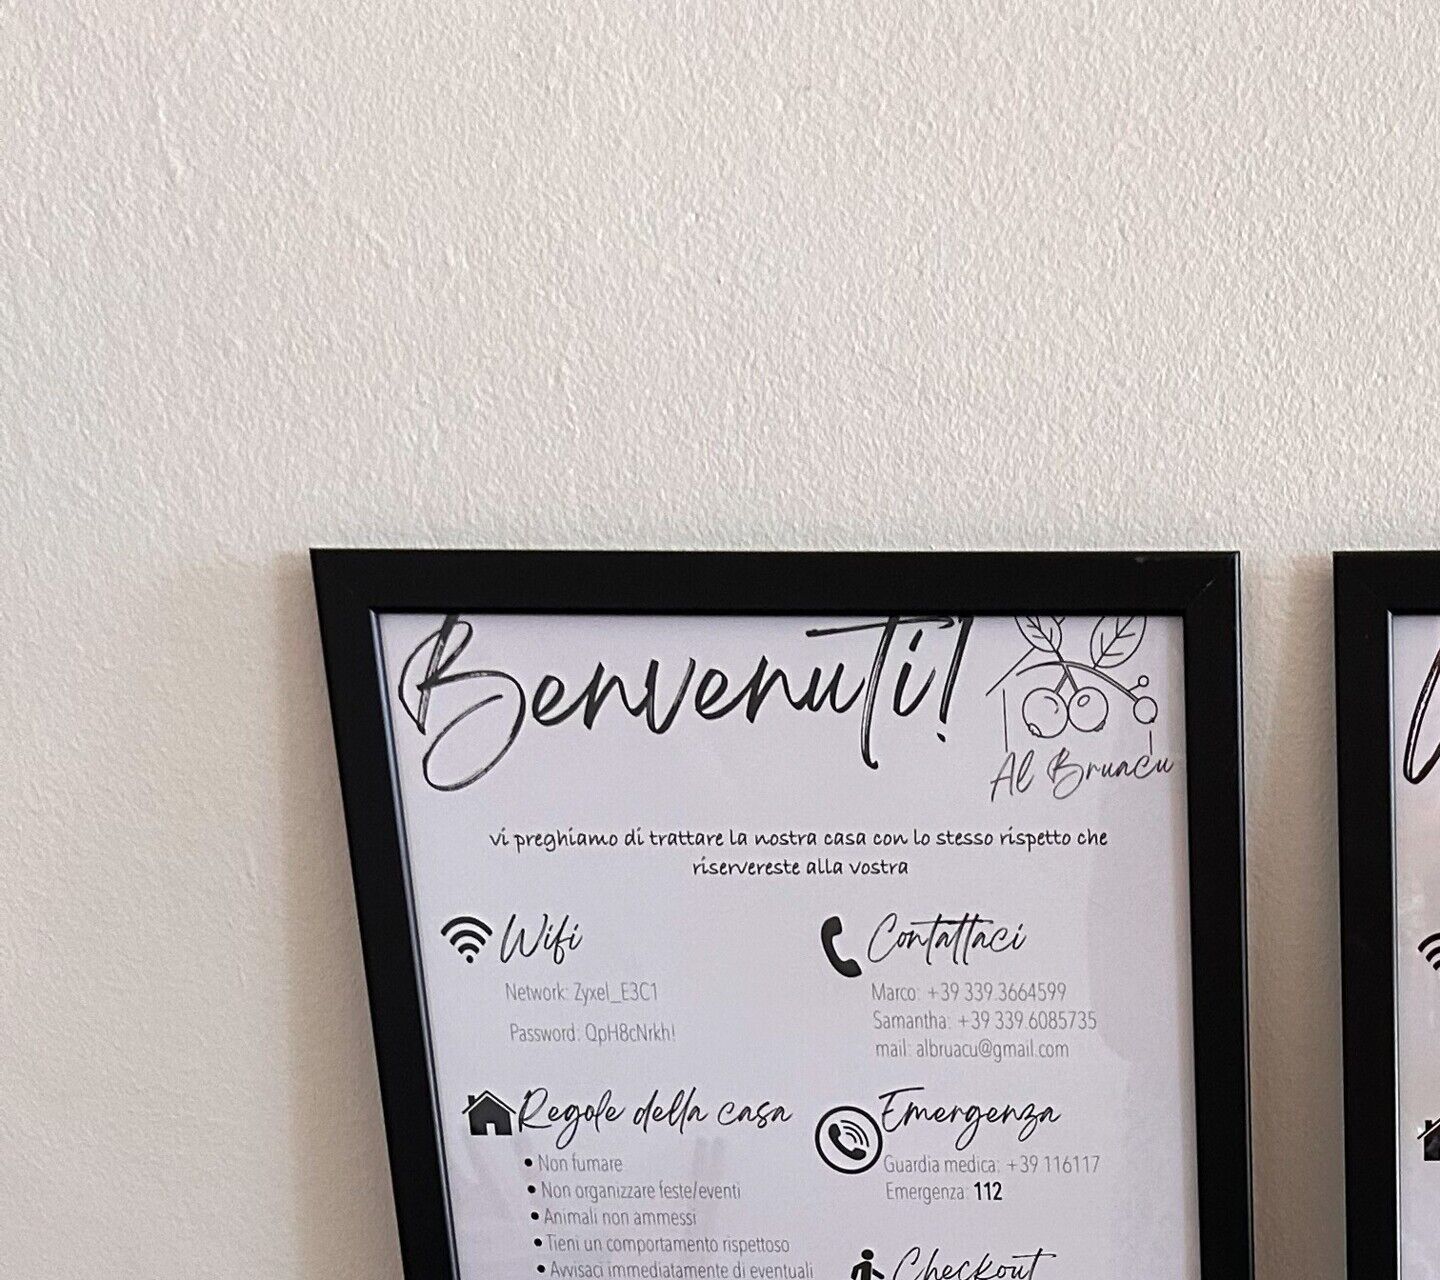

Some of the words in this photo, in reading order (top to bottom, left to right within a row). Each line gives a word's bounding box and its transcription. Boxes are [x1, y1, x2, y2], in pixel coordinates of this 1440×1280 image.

[398, 614, 976, 792] Benvenuti!
[989, 749, 1036, 802] Al
[1046, 747, 1176, 800] Bruacu
[489, 826, 510, 847] vi
[513, 826, 619, 854] preghiamo
[624, 826, 645, 847] di
[648, 830, 725, 847] trattare
[729, 828, 748, 846] la
[754, 830, 817, 847] nostra
[823, 832, 867, 846] casa
[872, 833, 909, 847] con
[913, 828, 931, 847] lo
[935, 829, 994, 847] stesso
[999, 825, 1072, 853] rispetto
[1077, 828, 1108, 846] che
[692, 855, 801, 876] riservereste
[806, 857, 844, 875] alla
[848, 858, 909, 876] vostra
[498, 913, 585, 966] Wifi
[866, 912, 1028, 966] Contattaci
[504, 981, 570, 1002] Network:
[572, 981, 659, 1007] Zyxel_E3C1
[871, 982, 922, 1003] Marco:
[927, 981, 961, 1002] +39
[963, 980, 1068, 1003] 339.3664599
[872, 1009, 953, 1030] Samantha:
[956, 1009, 992, 1031] +39
[993, 1009, 1099, 1031] 339.6085735
[584, 1021, 677, 1047] QpH8cNrkh!
[875, 1037, 913, 1058] mail:
[915, 1037, 1070, 1064] albruacu@gmail.com
[517, 1087, 627, 1151] Regole
[632, 1086, 710, 1135] della
[716, 1100, 795, 1130] casa
[878, 1086, 1062, 1153] Emergenza
[537, 1153, 570, 1173] Non
[570, 1152, 624, 1173] fumare
[882, 1154, 941, 1174] Guardia
[943, 1154, 1001, 1176] medica:
[1005, 1154, 1040, 1174] +39
[1042, 1154, 1102, 1174] 116117
[540, 1180, 572, 1200] Non
[574, 1184, 656, 1204] organizzare
[657, 1179, 741, 1201] feste/eventi
[972, 1181, 1005, 1202] 112
[543, 1206, 599, 1227] Animali
[601, 1211, 631, 1227] non
[632, 1210, 698, 1227] ammessi
